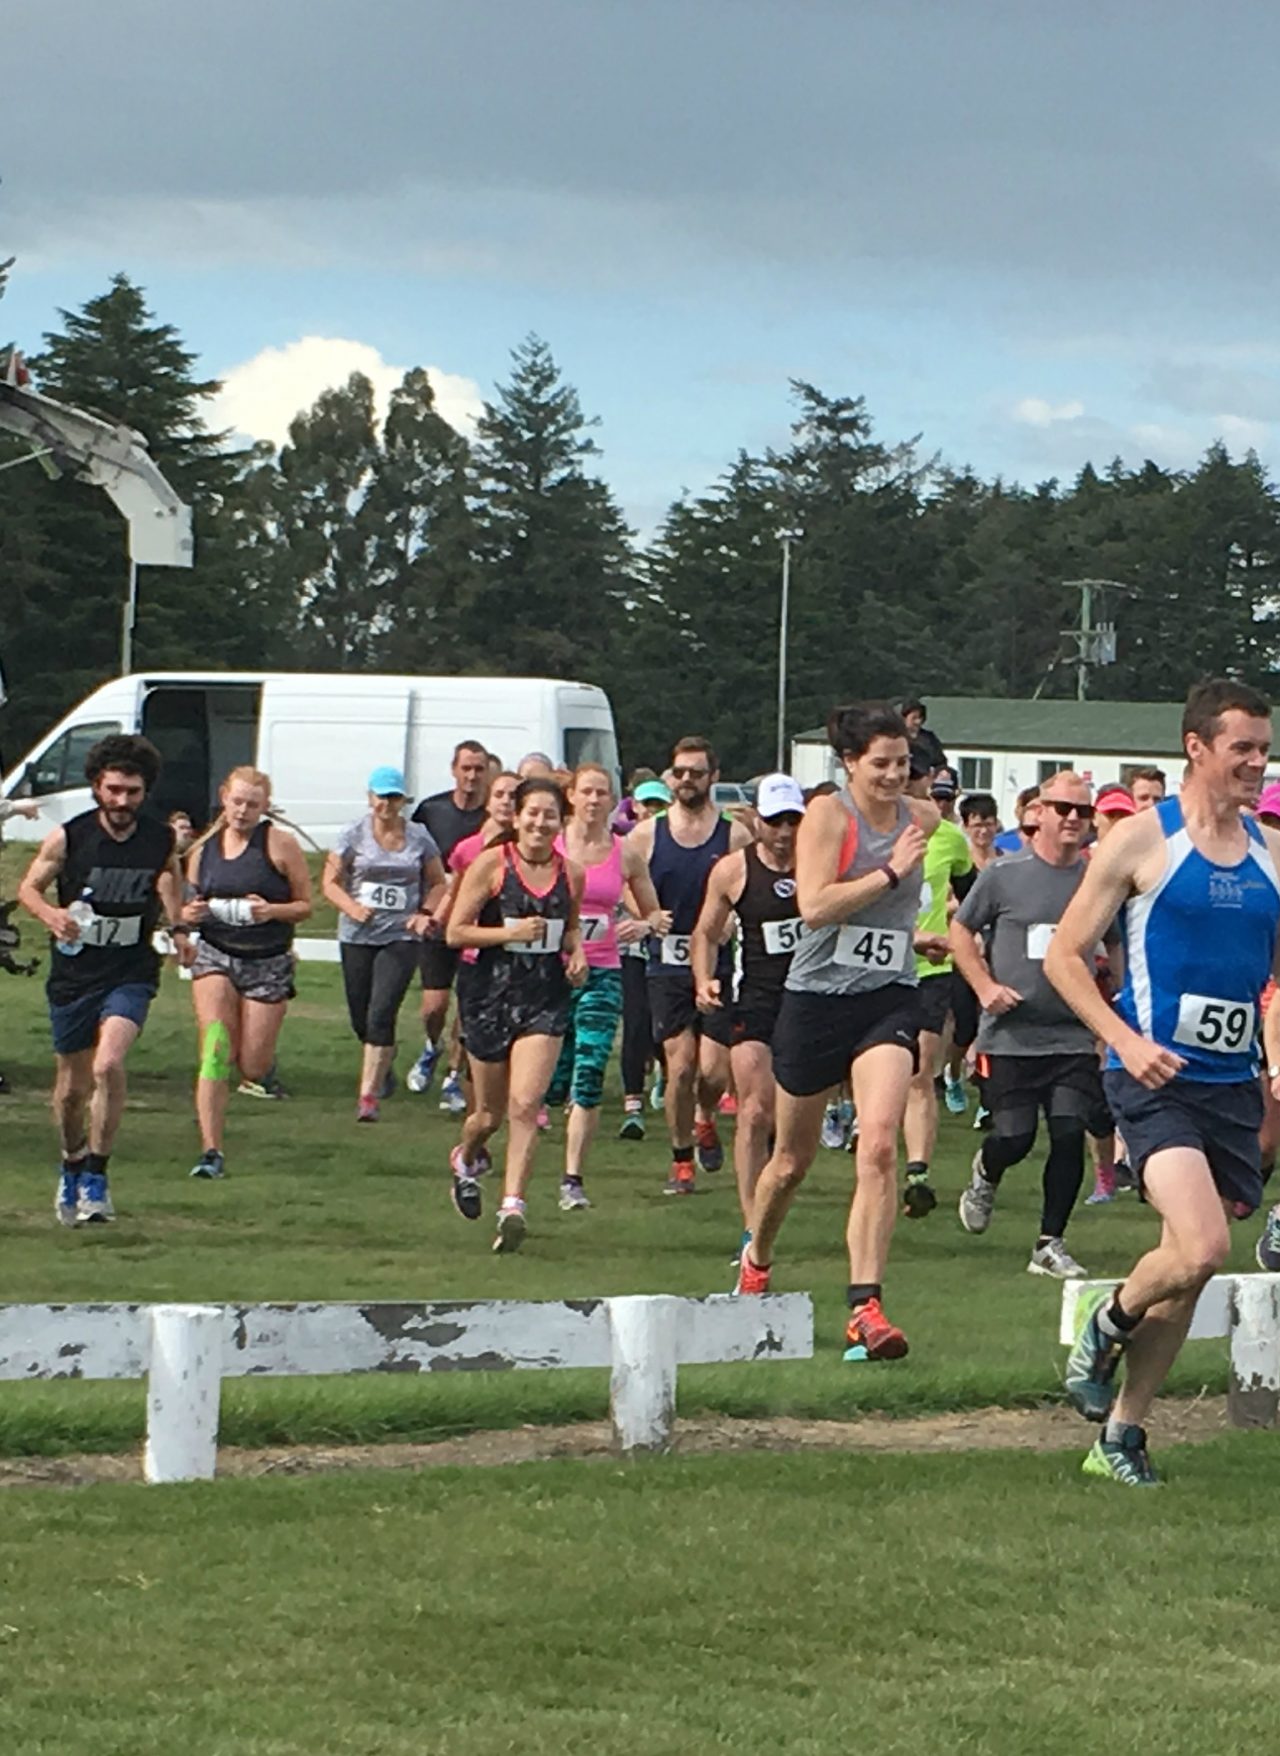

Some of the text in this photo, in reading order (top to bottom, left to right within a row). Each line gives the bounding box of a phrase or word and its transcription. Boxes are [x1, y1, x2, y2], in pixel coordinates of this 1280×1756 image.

[371, 886, 398, 907] 46
[92, 918, 121, 947] 12
[853, 932, 895, 966] 45
[1196, 1004, 1247, 1047] 59
